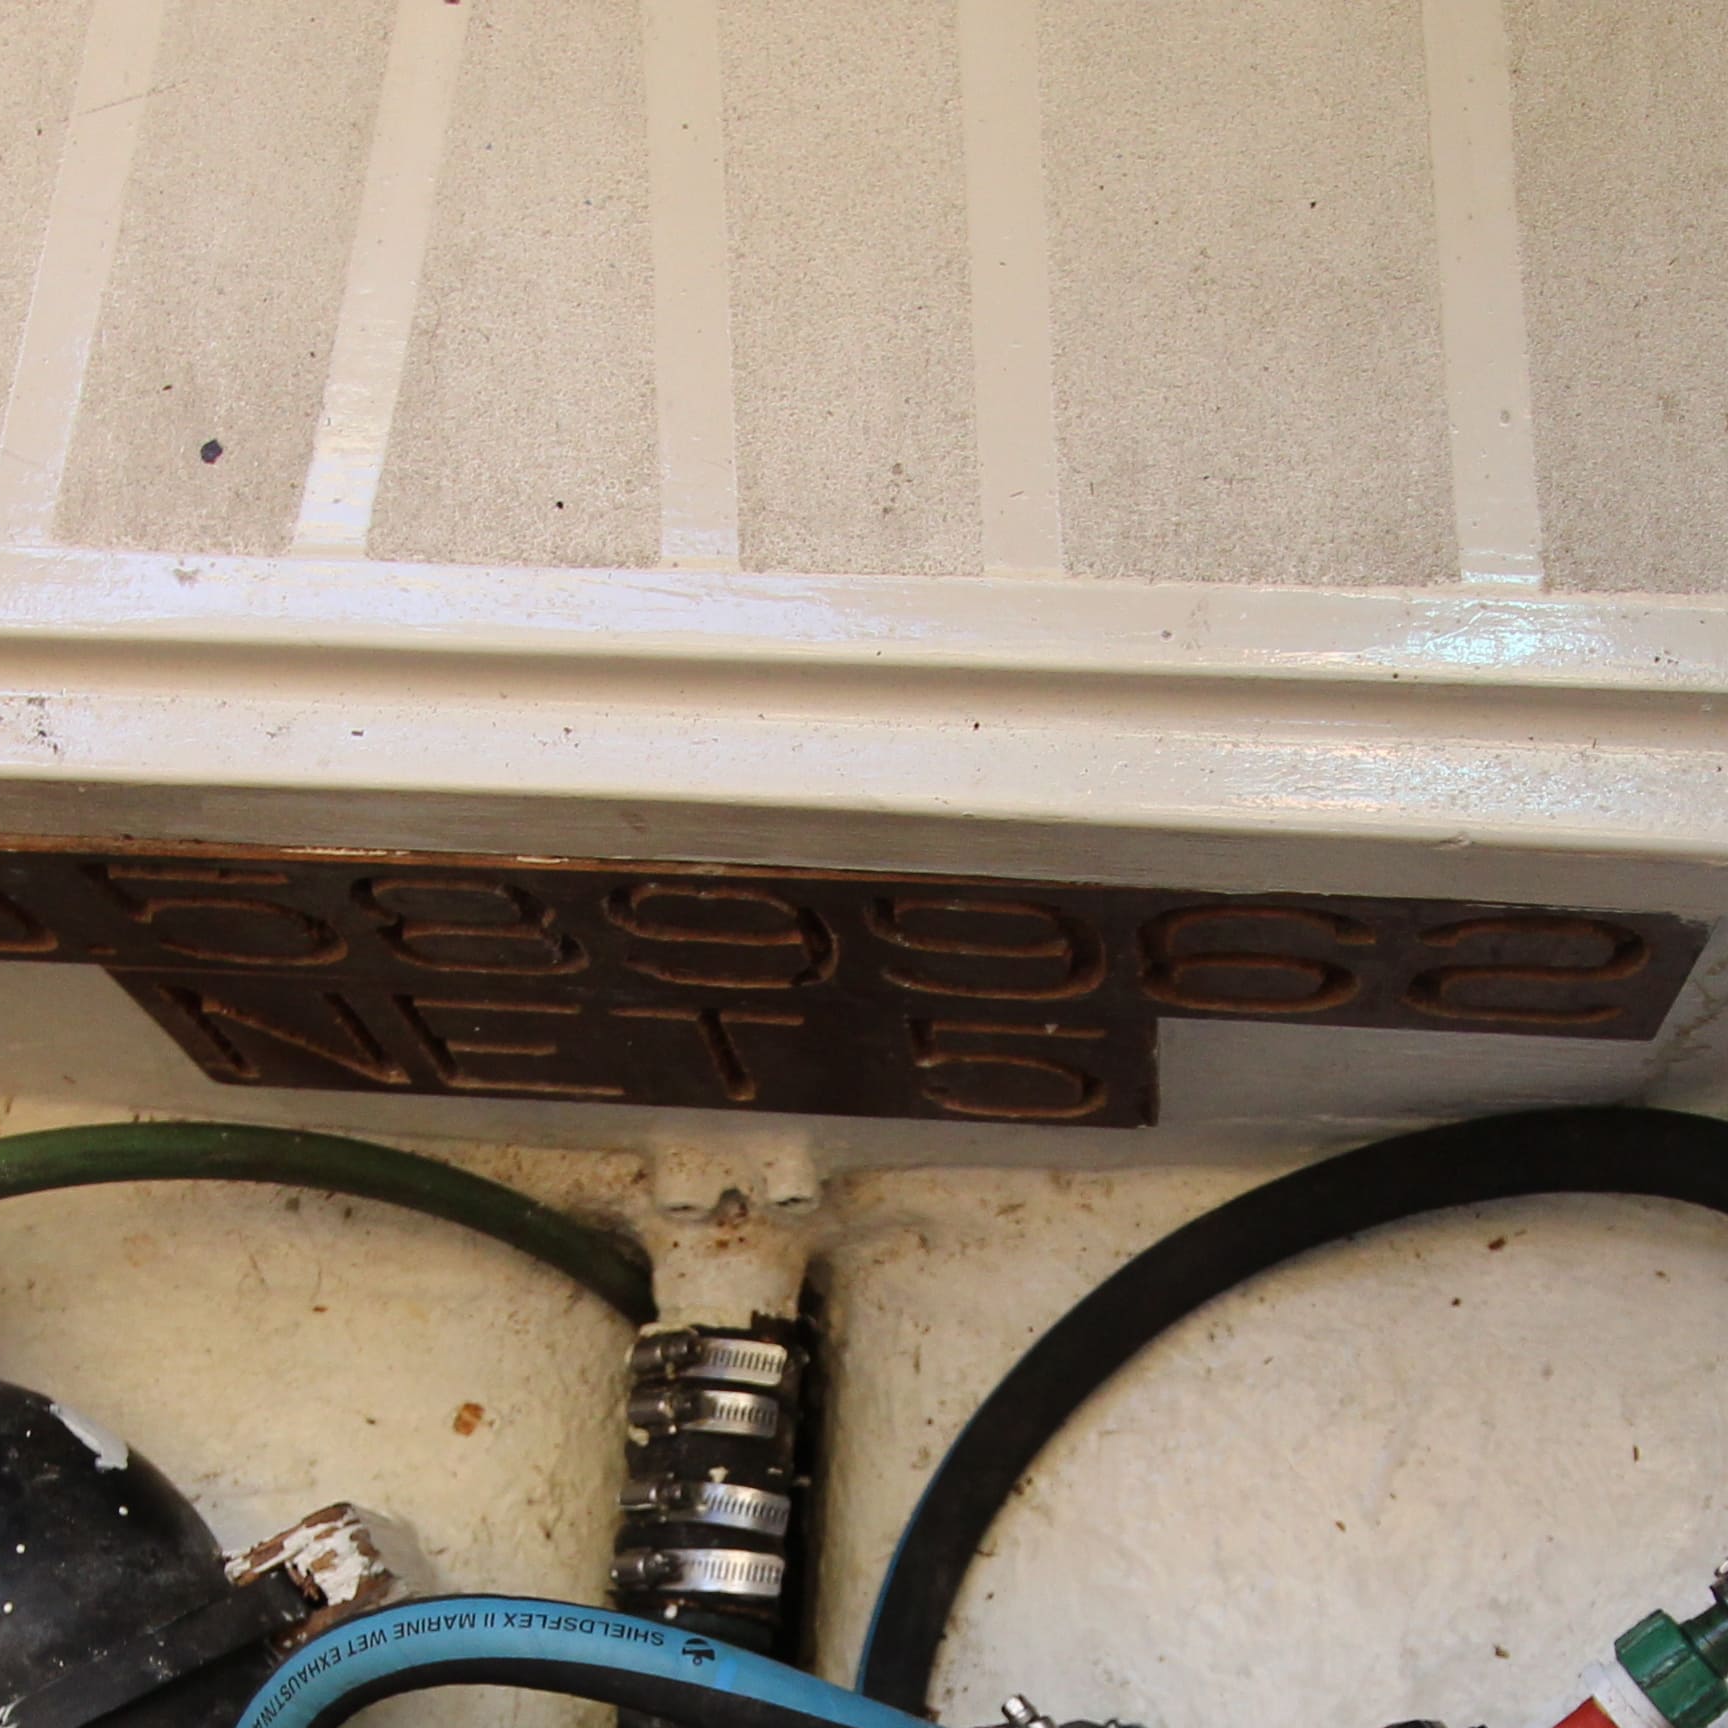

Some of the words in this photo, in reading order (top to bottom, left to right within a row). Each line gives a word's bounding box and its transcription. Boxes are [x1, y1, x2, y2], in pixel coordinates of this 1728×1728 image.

[156, 990, 803, 1103] NET
[904, 1012, 1107, 1120] 5
[393, 1613, 476, 1640] MARINE
[483, 1612, 495, 1629] II
[504, 1612, 665, 1647] SHIELDSFLEX
[346, 1629, 387, 1658] WET
